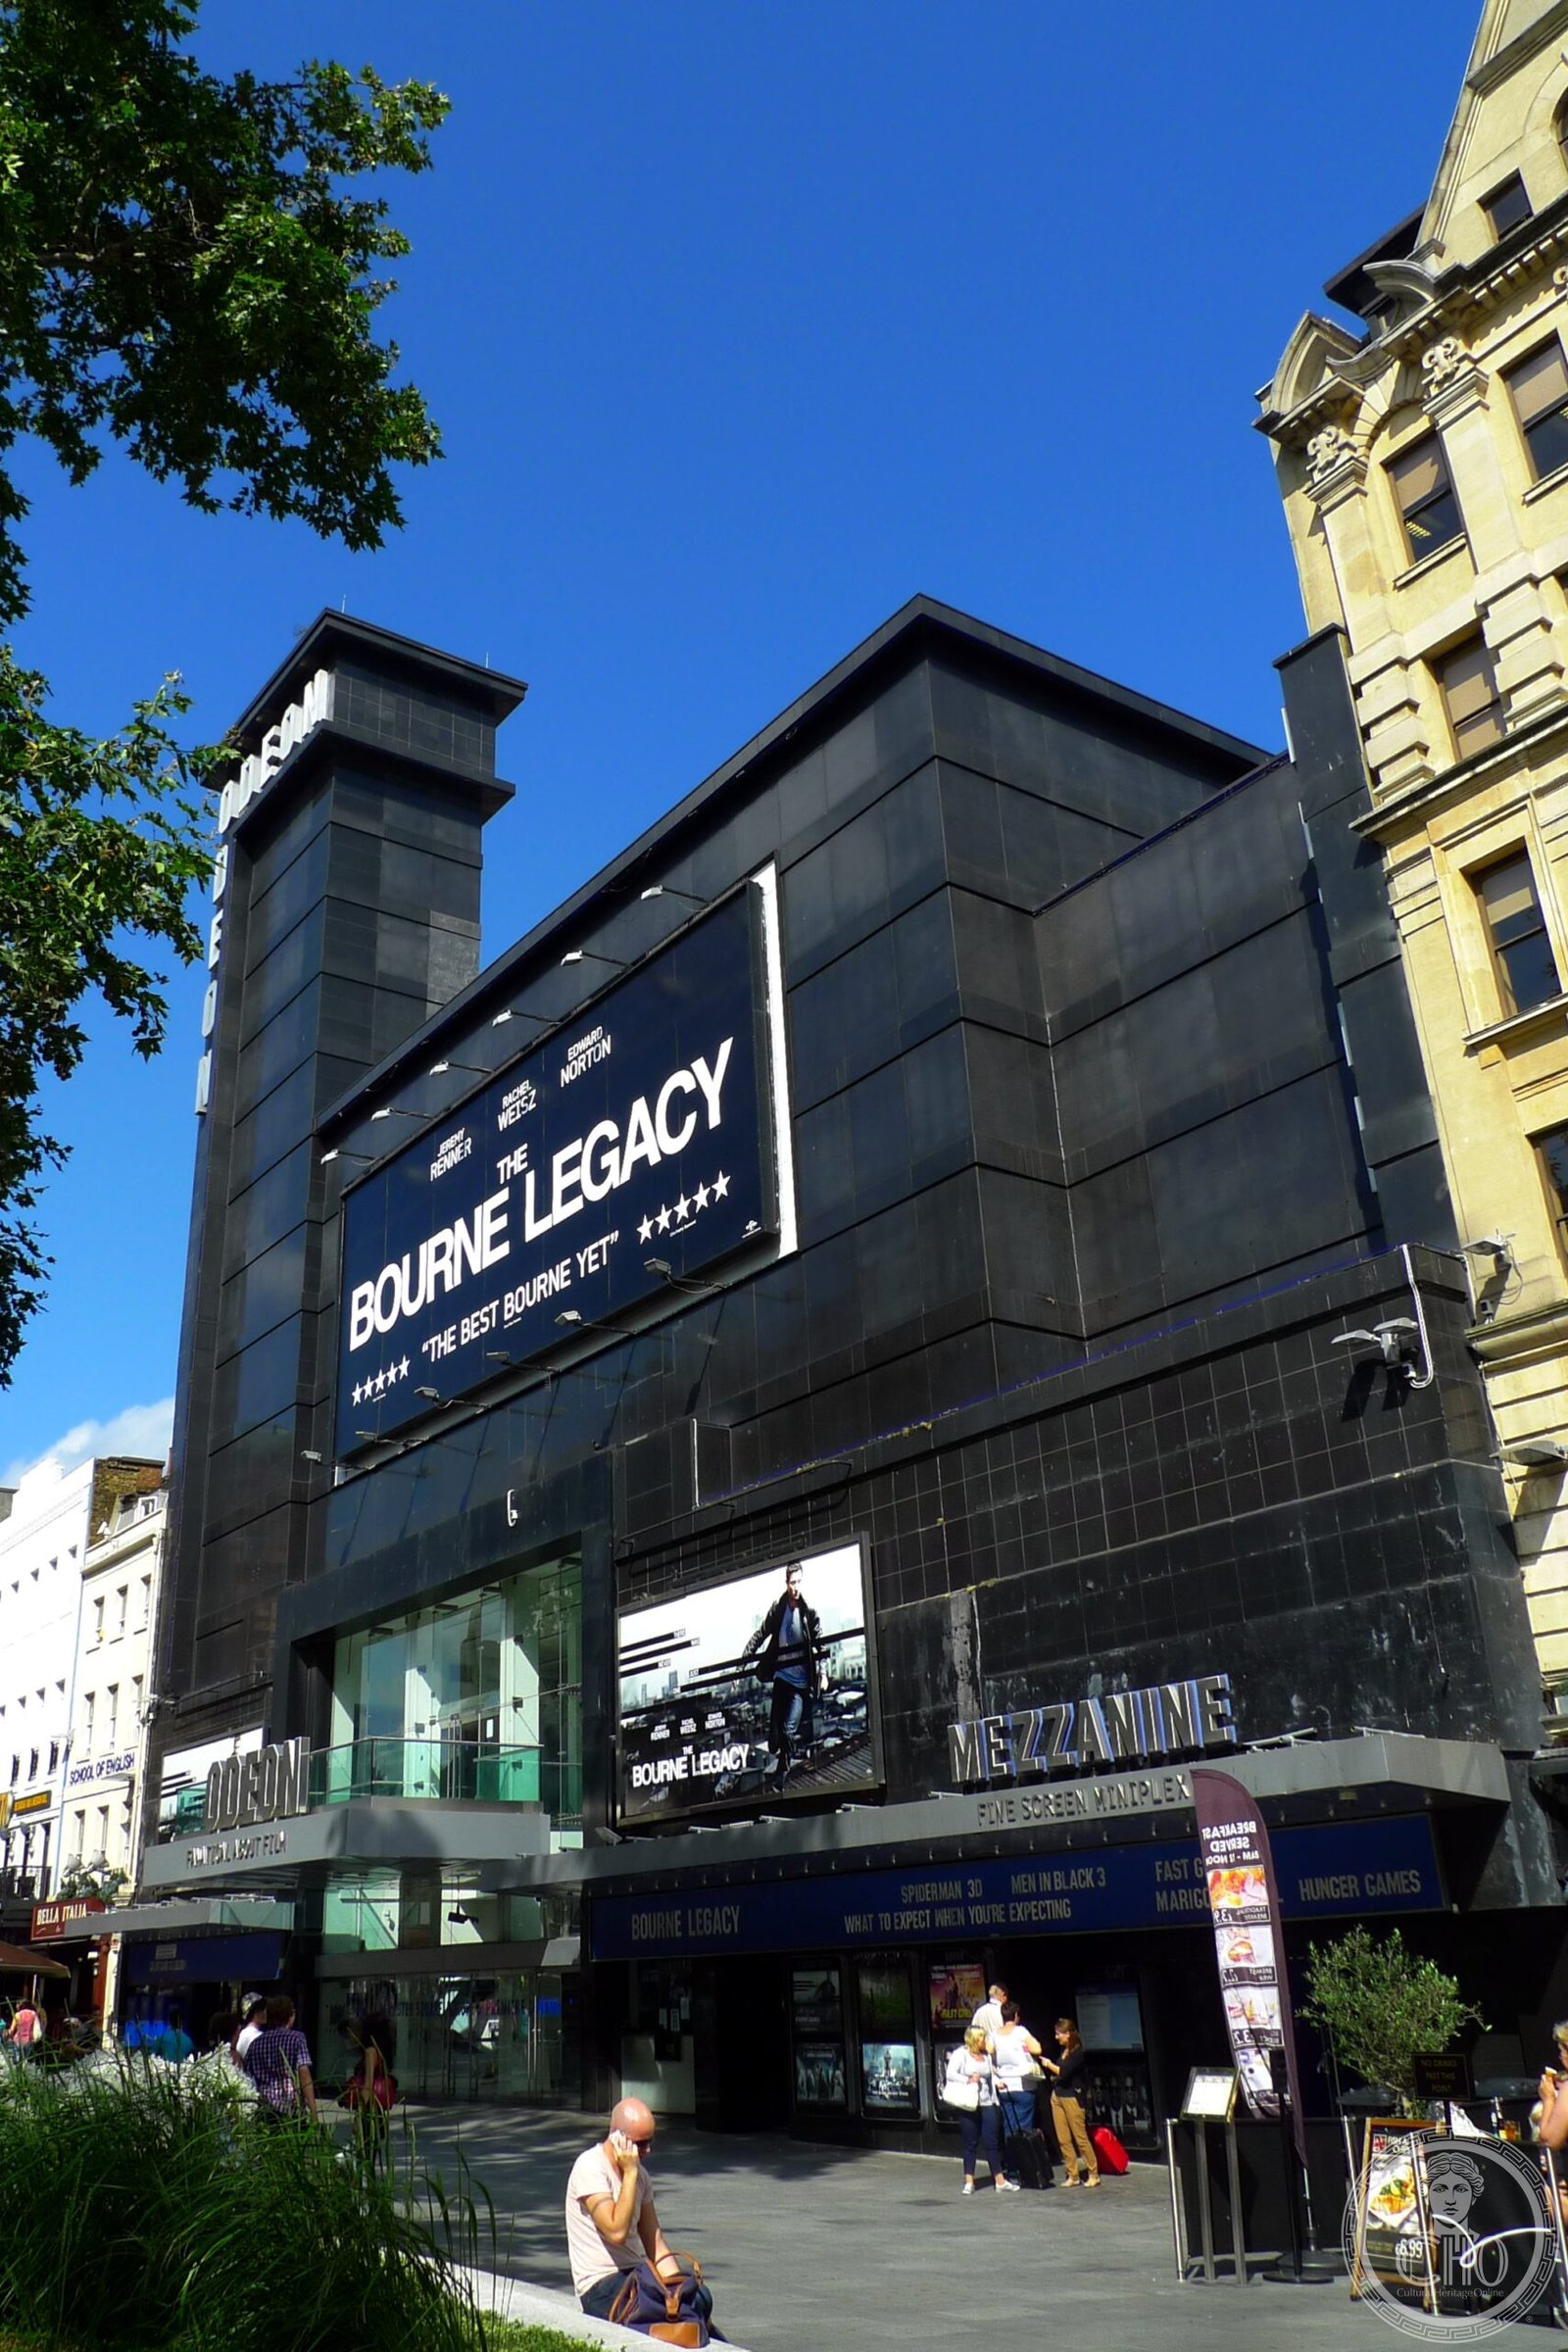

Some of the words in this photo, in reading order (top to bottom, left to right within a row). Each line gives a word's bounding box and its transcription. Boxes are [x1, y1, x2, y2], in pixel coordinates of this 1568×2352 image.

[219, 669, 335, 834] ODEON
[561, 1035, 611, 1088] NORTON
[568, 1026, 603, 1061] EDWARD
[498, 1089, 536, 1131] WEISZ
[503, 1079, 532, 1109] RACHEL
[437, 1127, 465, 1156] JEREMY
[430, 1138, 471, 1182] RENNER
[497, 1143, 528, 1184] THE
[350, 1187, 510, 1351] BOURNE
[525, 1036, 734, 1243] LEGACY
[461, 1300, 499, 1347] BEST
[504, 1258, 571, 1321] BOURNE
[947, 1673, 1238, 1784] MEZZANINE
[632, 1756, 688, 1788] BOURNE
[692, 1743, 750, 1777] LEGACY
[682, 1745, 693, 1755] THE
[70, 1764, 94, 1786] SCHOOL
[96, 1761, 105, 1777] OF
[106, 1751, 135, 1775] ENGLISH
[205, 1737, 311, 1830] ODEON
[1022, 1788, 1087, 1821] SCREEN
[1094, 1774, 1192, 1812] MINIPLEX
[1011, 1875, 1037, 1894] MEN
[1039, 1874, 1052, 1892] IN
[1054, 1869, 1095, 1891] BLACK
[1097, 1867, 1106, 1887] 3
[1155, 1859, 1190, 1883] FAST
[1298, 1874, 1360, 1901] HUNGER
[1364, 1869, 1422, 1897] GAMES
[901, 1880, 962, 1904] SPIDERMAN
[967, 1879, 983, 1898] 3D
[1155, 1886, 1210, 1912] MARIGO
[36, 1905, 61, 1926] BELLA
[62, 1903, 87, 1922] ITALIA
[631, 1910, 682, 1941] BOURNE
[687, 1905, 741, 1937] LEGACY
[844, 1914, 874, 1934] WHAT
[878, 1913, 891, 1932] TO
[894, 1909, 931, 1931] EXPECT
[934, 1906, 965, 1928] WHEN
[1009, 1898, 1072, 1922] EXPECTING
